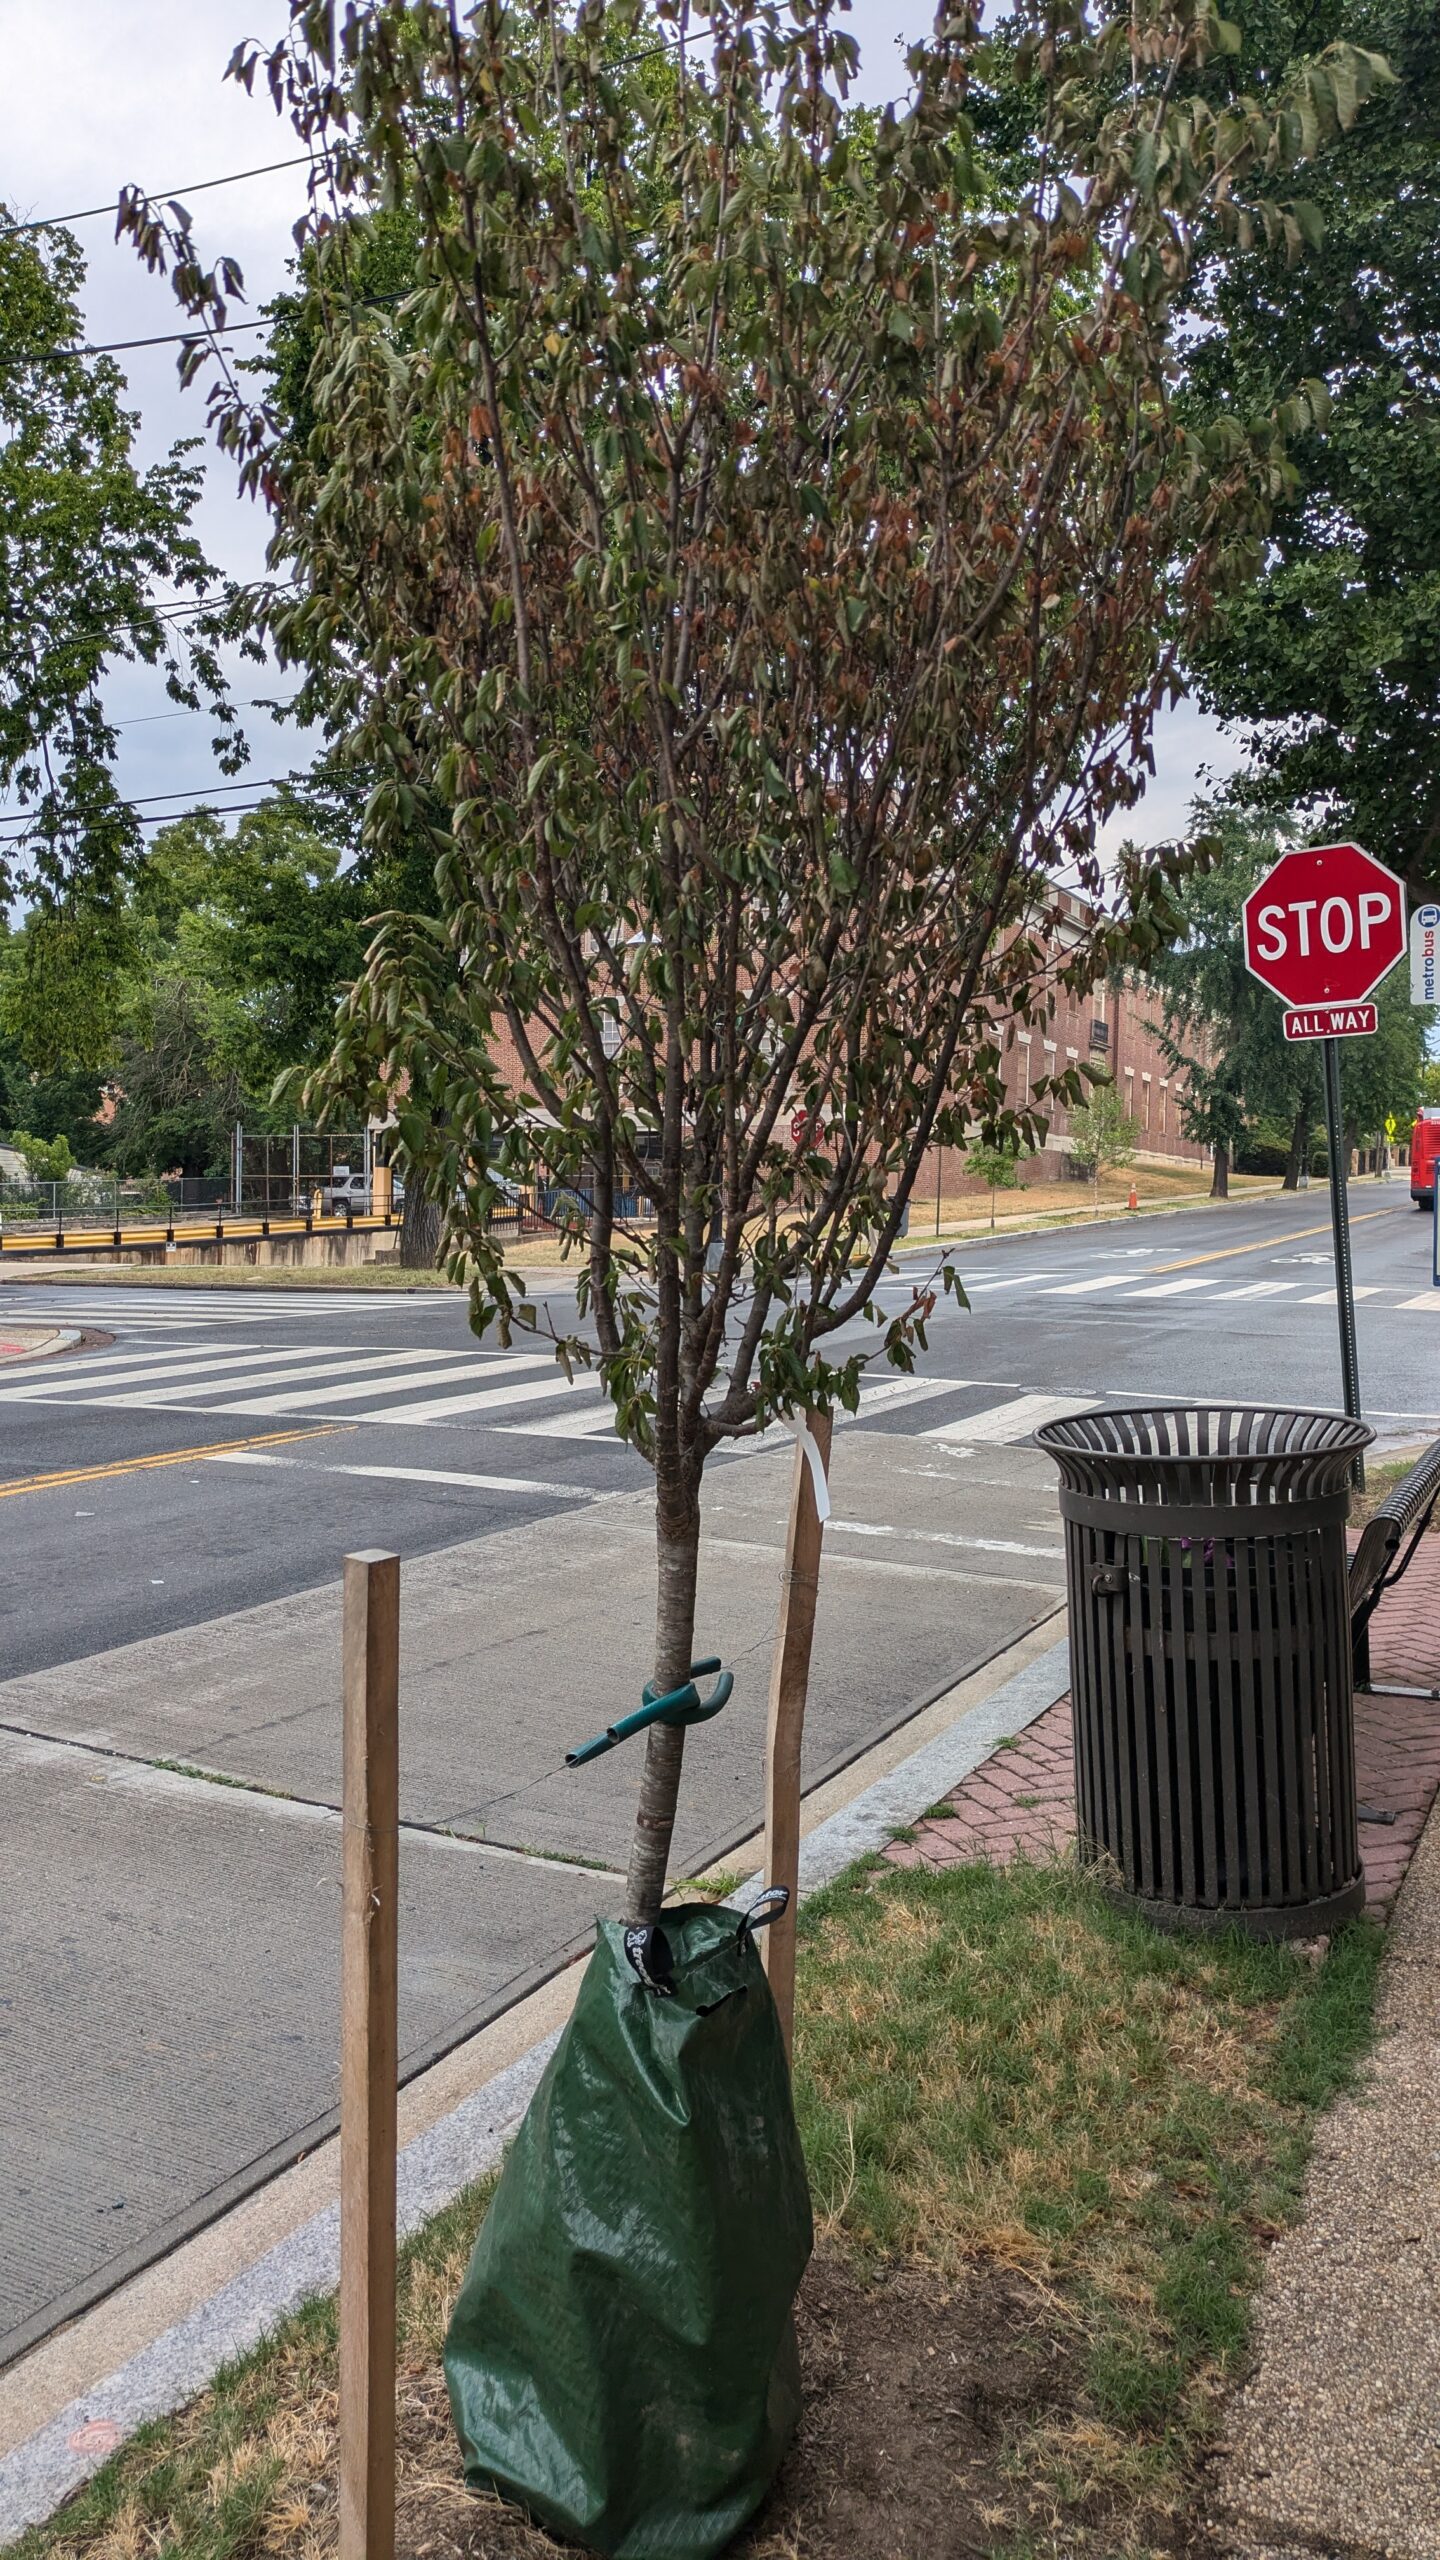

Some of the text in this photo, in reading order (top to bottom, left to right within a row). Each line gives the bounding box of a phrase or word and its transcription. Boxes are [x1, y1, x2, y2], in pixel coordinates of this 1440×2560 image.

[1257, 892, 1391, 961] STOP
[1421, 930, 1434, 1000] metrobus
[1291, 1010, 1370, 1035] ALL WAY
[792, 1121, 822, 1137] SP
